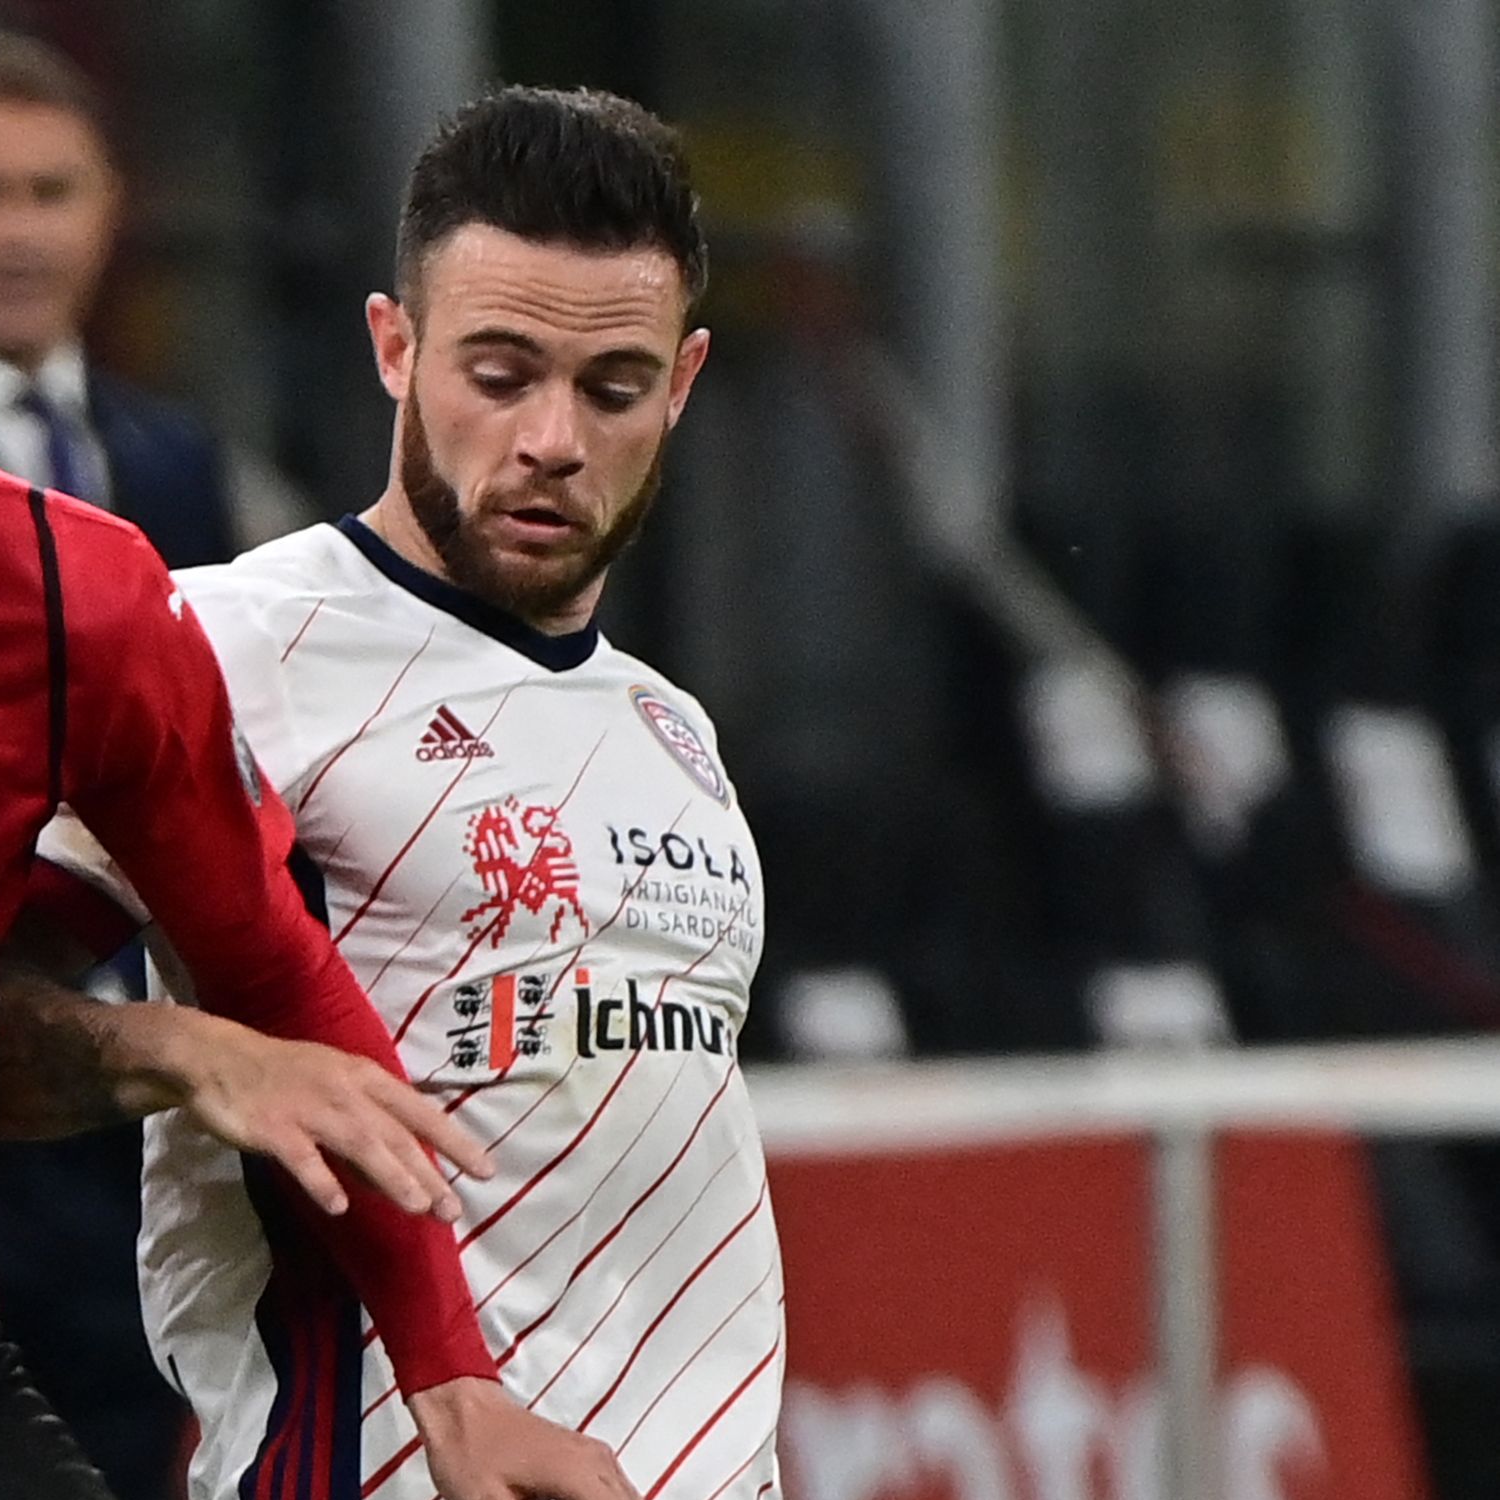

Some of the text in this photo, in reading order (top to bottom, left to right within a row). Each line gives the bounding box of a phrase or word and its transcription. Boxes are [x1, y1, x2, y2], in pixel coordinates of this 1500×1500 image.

[416, 741, 495, 762] adidas
[606, 825, 750, 894] ISOLA
[626, 907, 649, 930] DI
[573, 967, 735, 1059] ichnu
